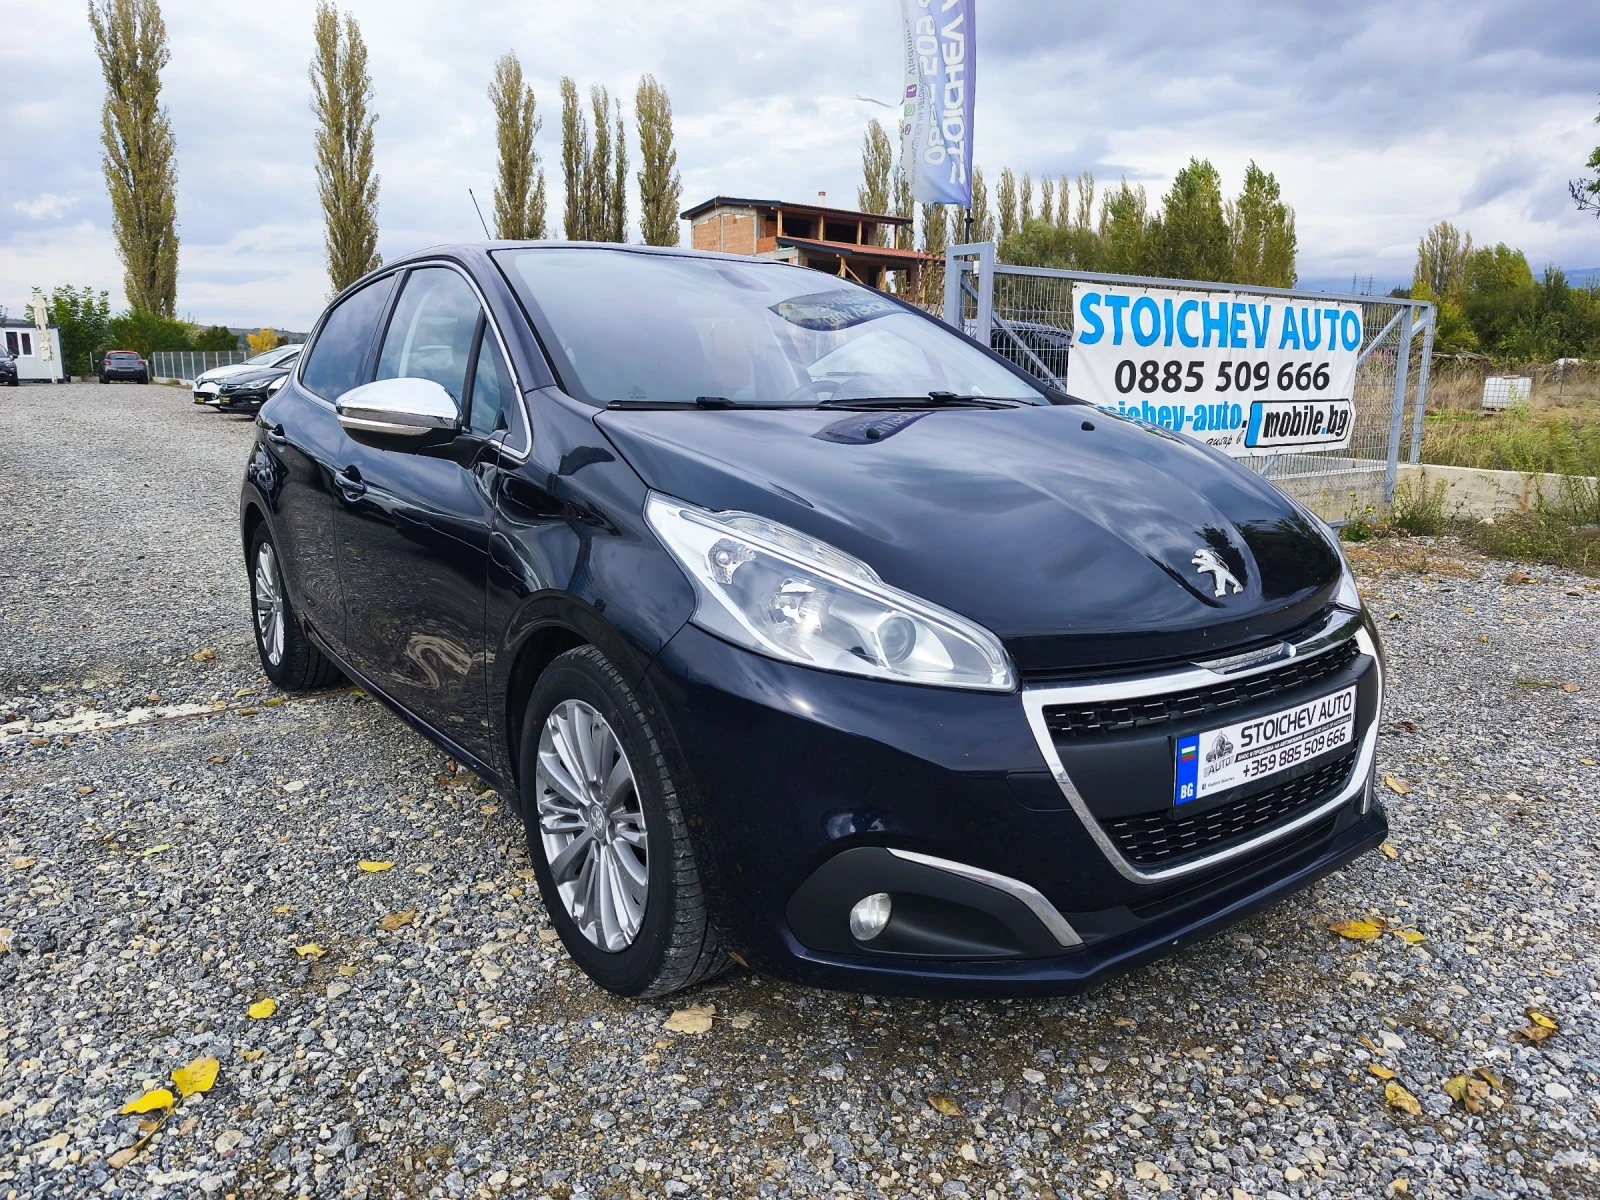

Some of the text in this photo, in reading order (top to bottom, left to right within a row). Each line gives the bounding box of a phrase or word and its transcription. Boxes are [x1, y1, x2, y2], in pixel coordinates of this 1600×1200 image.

[1079, 292, 1361, 351] STOICHEV AUTO
[1114, 359, 1330, 393] 0885 509 666
[1263, 404, 1348, 438] mobile.bg
[1241, 692, 1352, 748] STOICHEV AUTO
[1243, 726, 1346, 777] +359 885 509 666
[1180, 782, 1194, 799] BG
